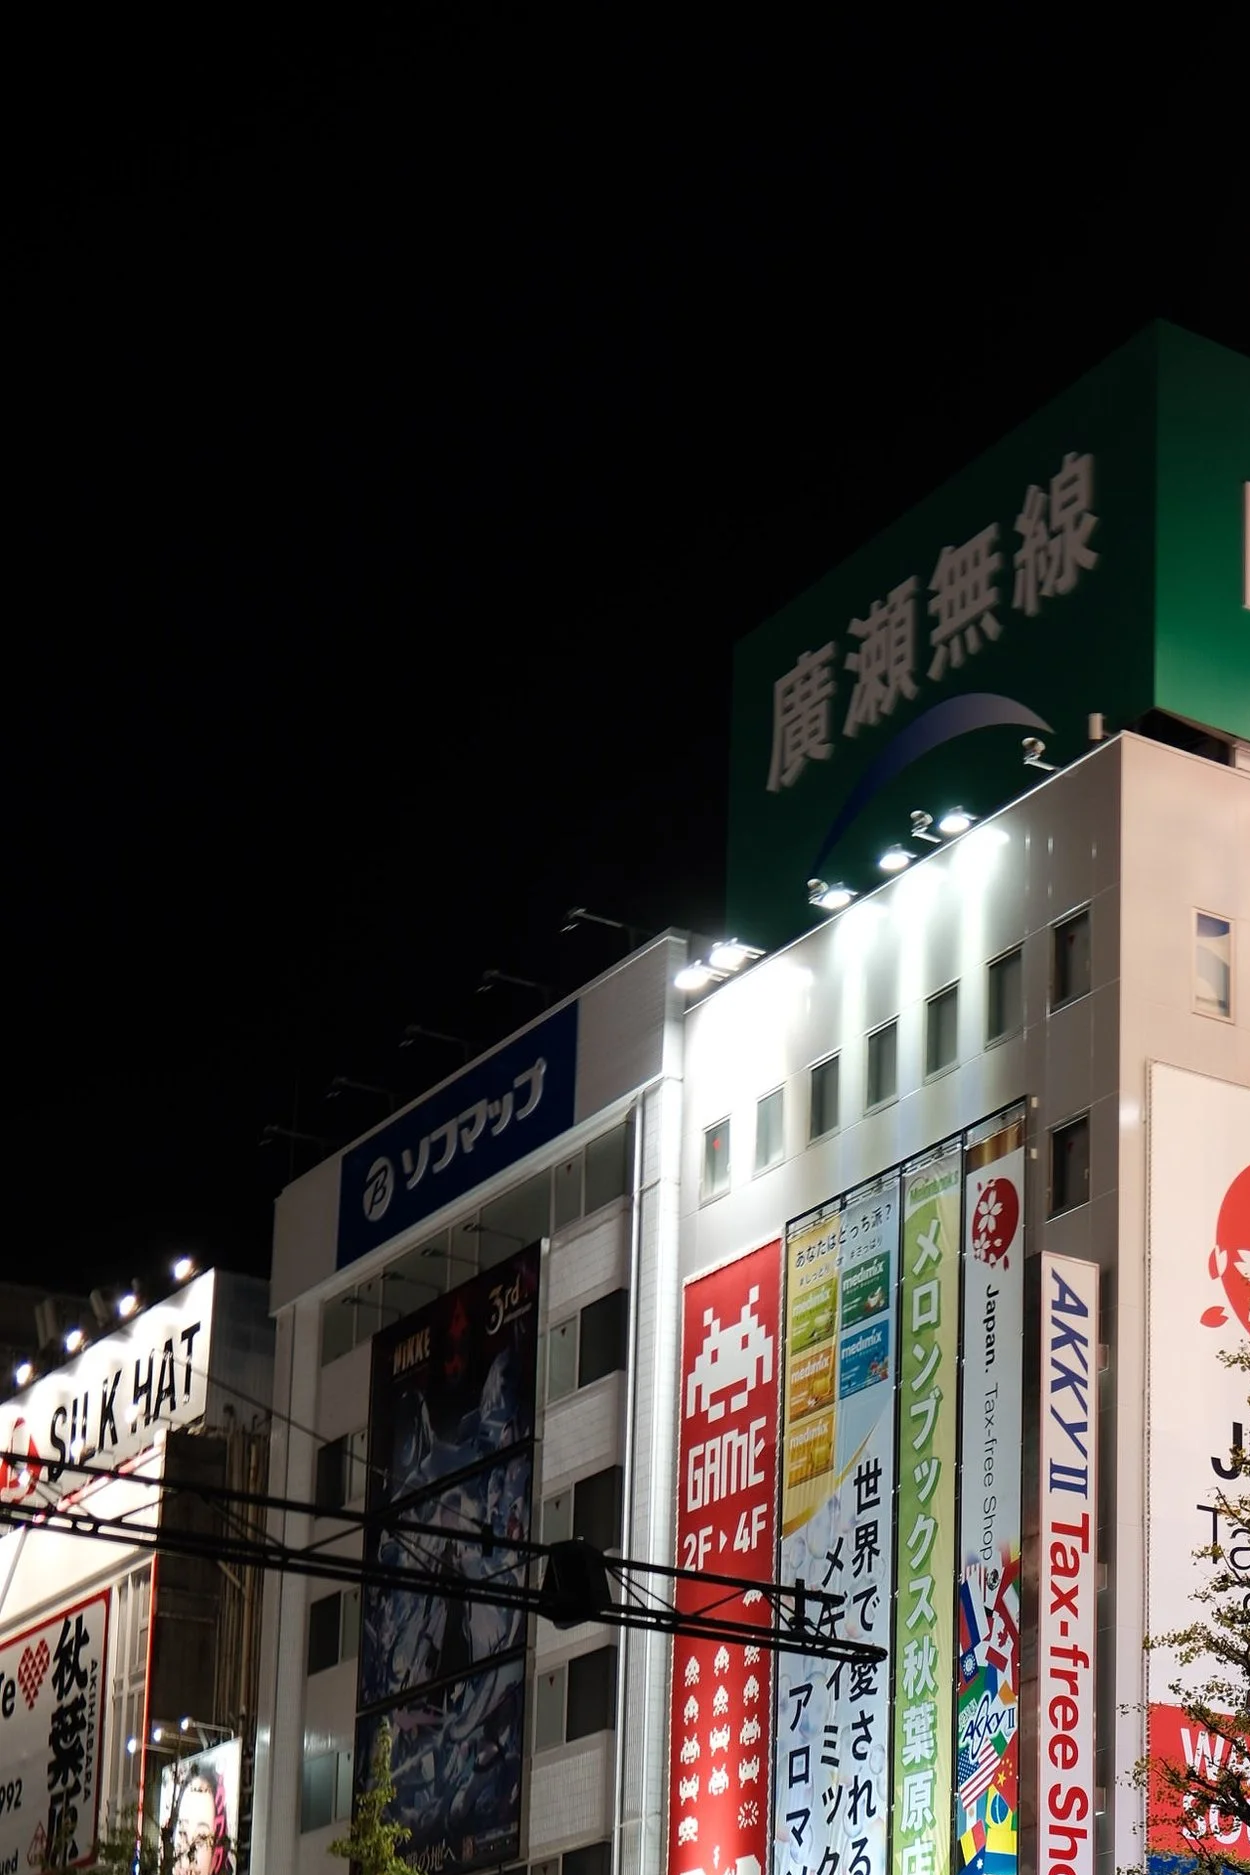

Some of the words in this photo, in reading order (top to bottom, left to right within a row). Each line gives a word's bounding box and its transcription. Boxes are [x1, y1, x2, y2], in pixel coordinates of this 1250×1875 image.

[766, 452, 1100, 793] 廣瀬無線
[401, 1056, 548, 1191] ソフマップ
[842, 1258, 885, 1293] medimix
[984, 1283, 1001, 1375] Japan.
[49, 1368, 122, 1482] SILK
[131, 1321, 201, 1436] HAT
[840, 1329, 883, 1361] medimix
[1050, 1267, 1089, 1460] AKKY
[687, 1416, 767, 1514] GAME
[982, 1382, 999, 1488] Tax-free
[981, 1492, 998, 1563] Shop
[1048, 1511, 1091, 1769] Tax-free
[48, 1614, 90, 1866] 秋葉原
[83, 1658, 98, 1805] AKIHABARA
